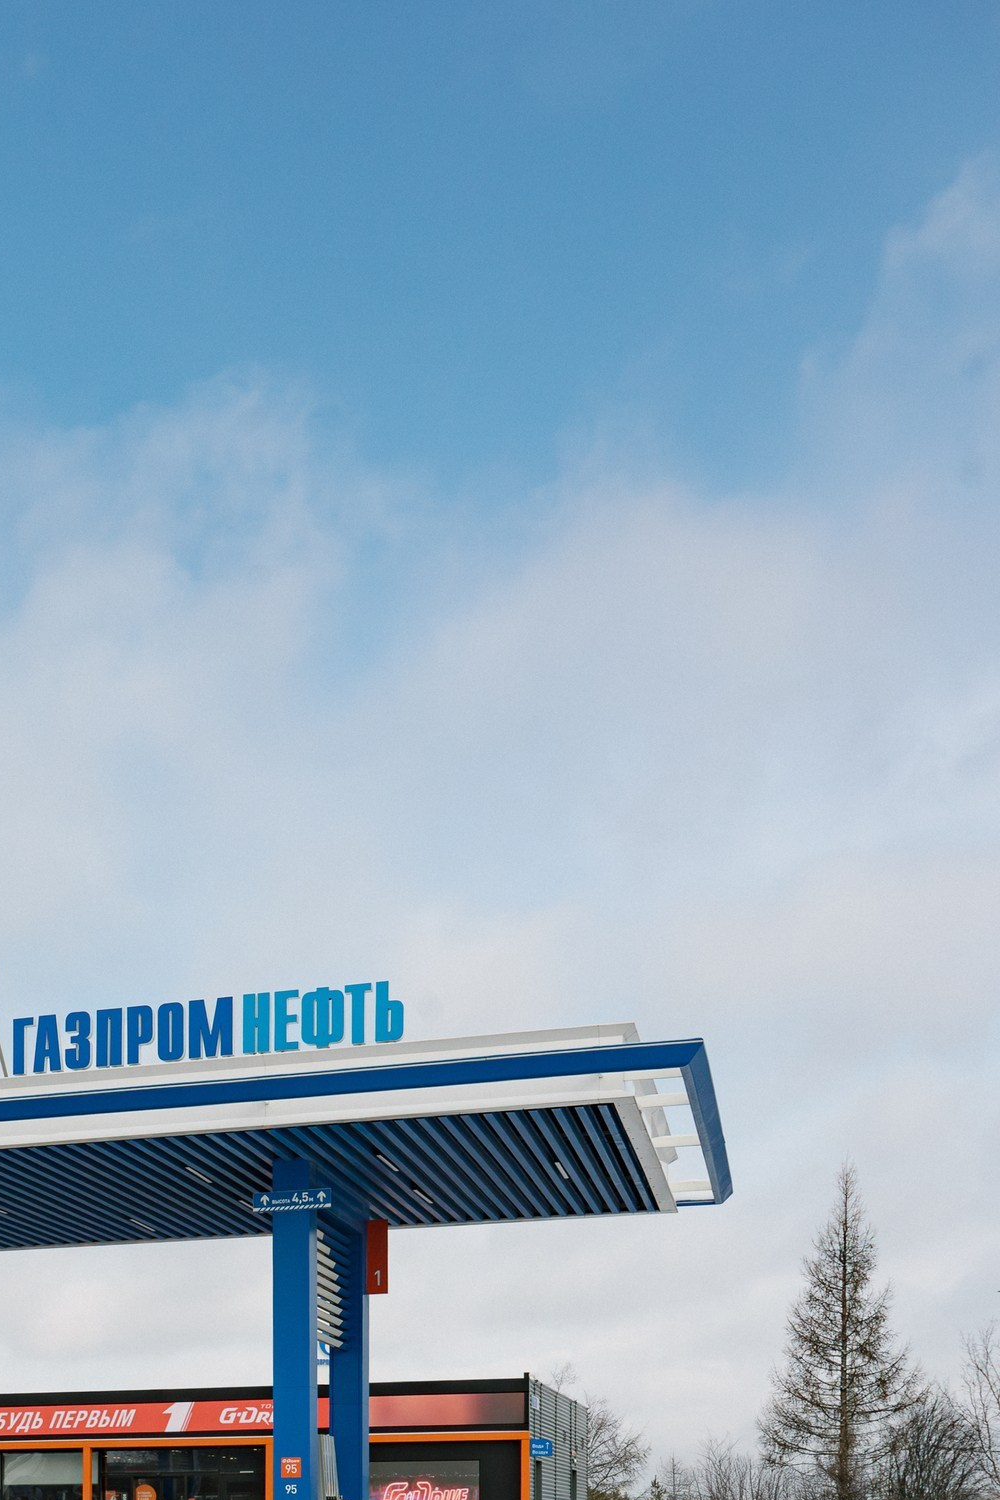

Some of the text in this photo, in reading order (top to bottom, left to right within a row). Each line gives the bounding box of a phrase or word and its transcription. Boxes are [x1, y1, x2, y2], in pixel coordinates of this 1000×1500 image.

[374, 1269, 381, 1287] 1
[48, 1408, 137, 1430] ПЕРВЫМ
[285, 1464, 298, 1474] 95
[285, 1484, 298, 1495] 95
